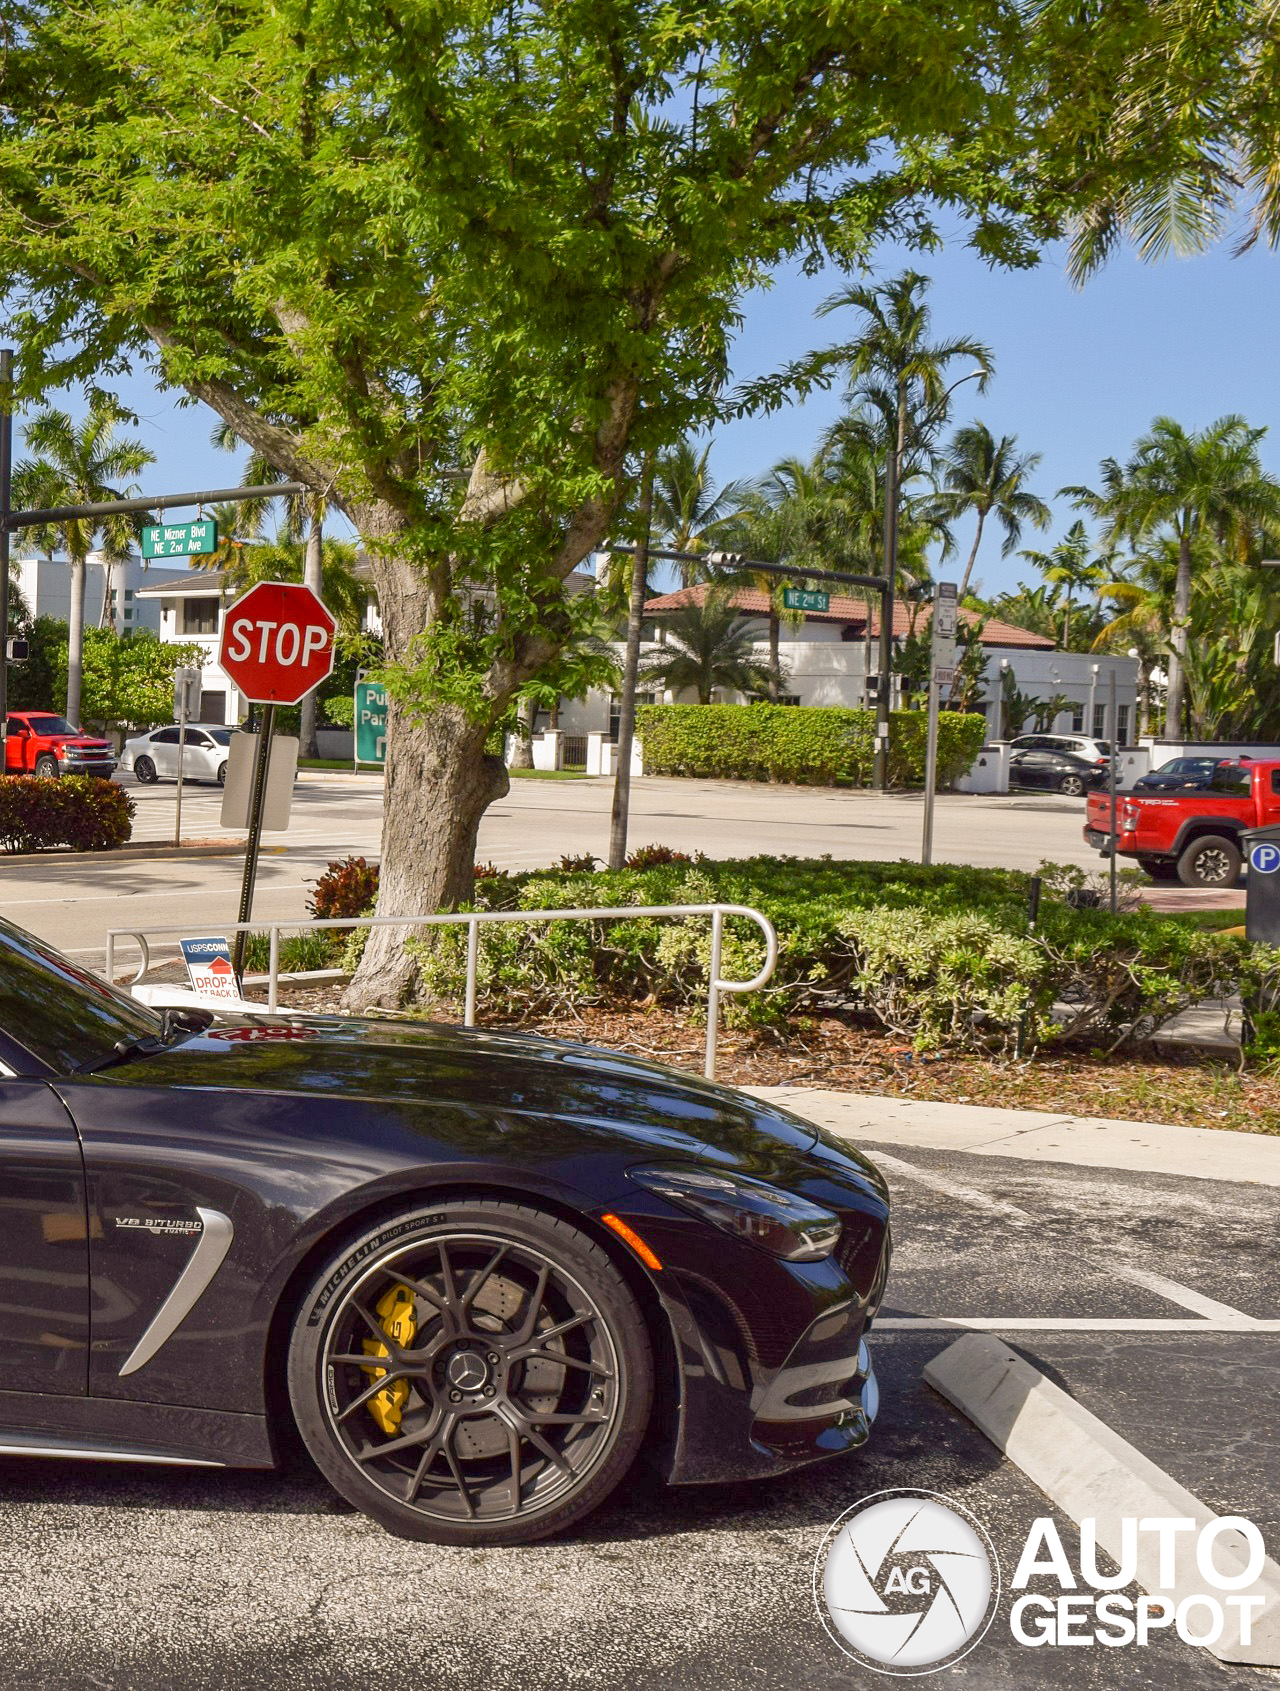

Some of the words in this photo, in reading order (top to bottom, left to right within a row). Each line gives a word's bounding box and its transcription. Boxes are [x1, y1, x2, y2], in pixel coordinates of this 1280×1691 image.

[150, 530, 160, 542] NE
[164, 528, 187, 540] Mizner
[191, 525, 206, 538] Blvd
[154, 542, 165, 554] NE
[170, 541, 183, 553] 2nd
[187, 539, 202, 551] Ave
[789, 593, 799, 606] NE
[802, 594, 815, 607] 2nd
[817, 595, 826, 609] St
[228, 618, 328, 667] STOP
[1260, 848, 1276, 869] P
[115, 1217, 140, 1226] V8
[145, 1218, 202, 1228] BITURBO
[320, 1237, 380, 1306] MICHELIN
[382, 1226, 403, 1241] PILOT
[404, 1217, 430, 1231] SPORT
